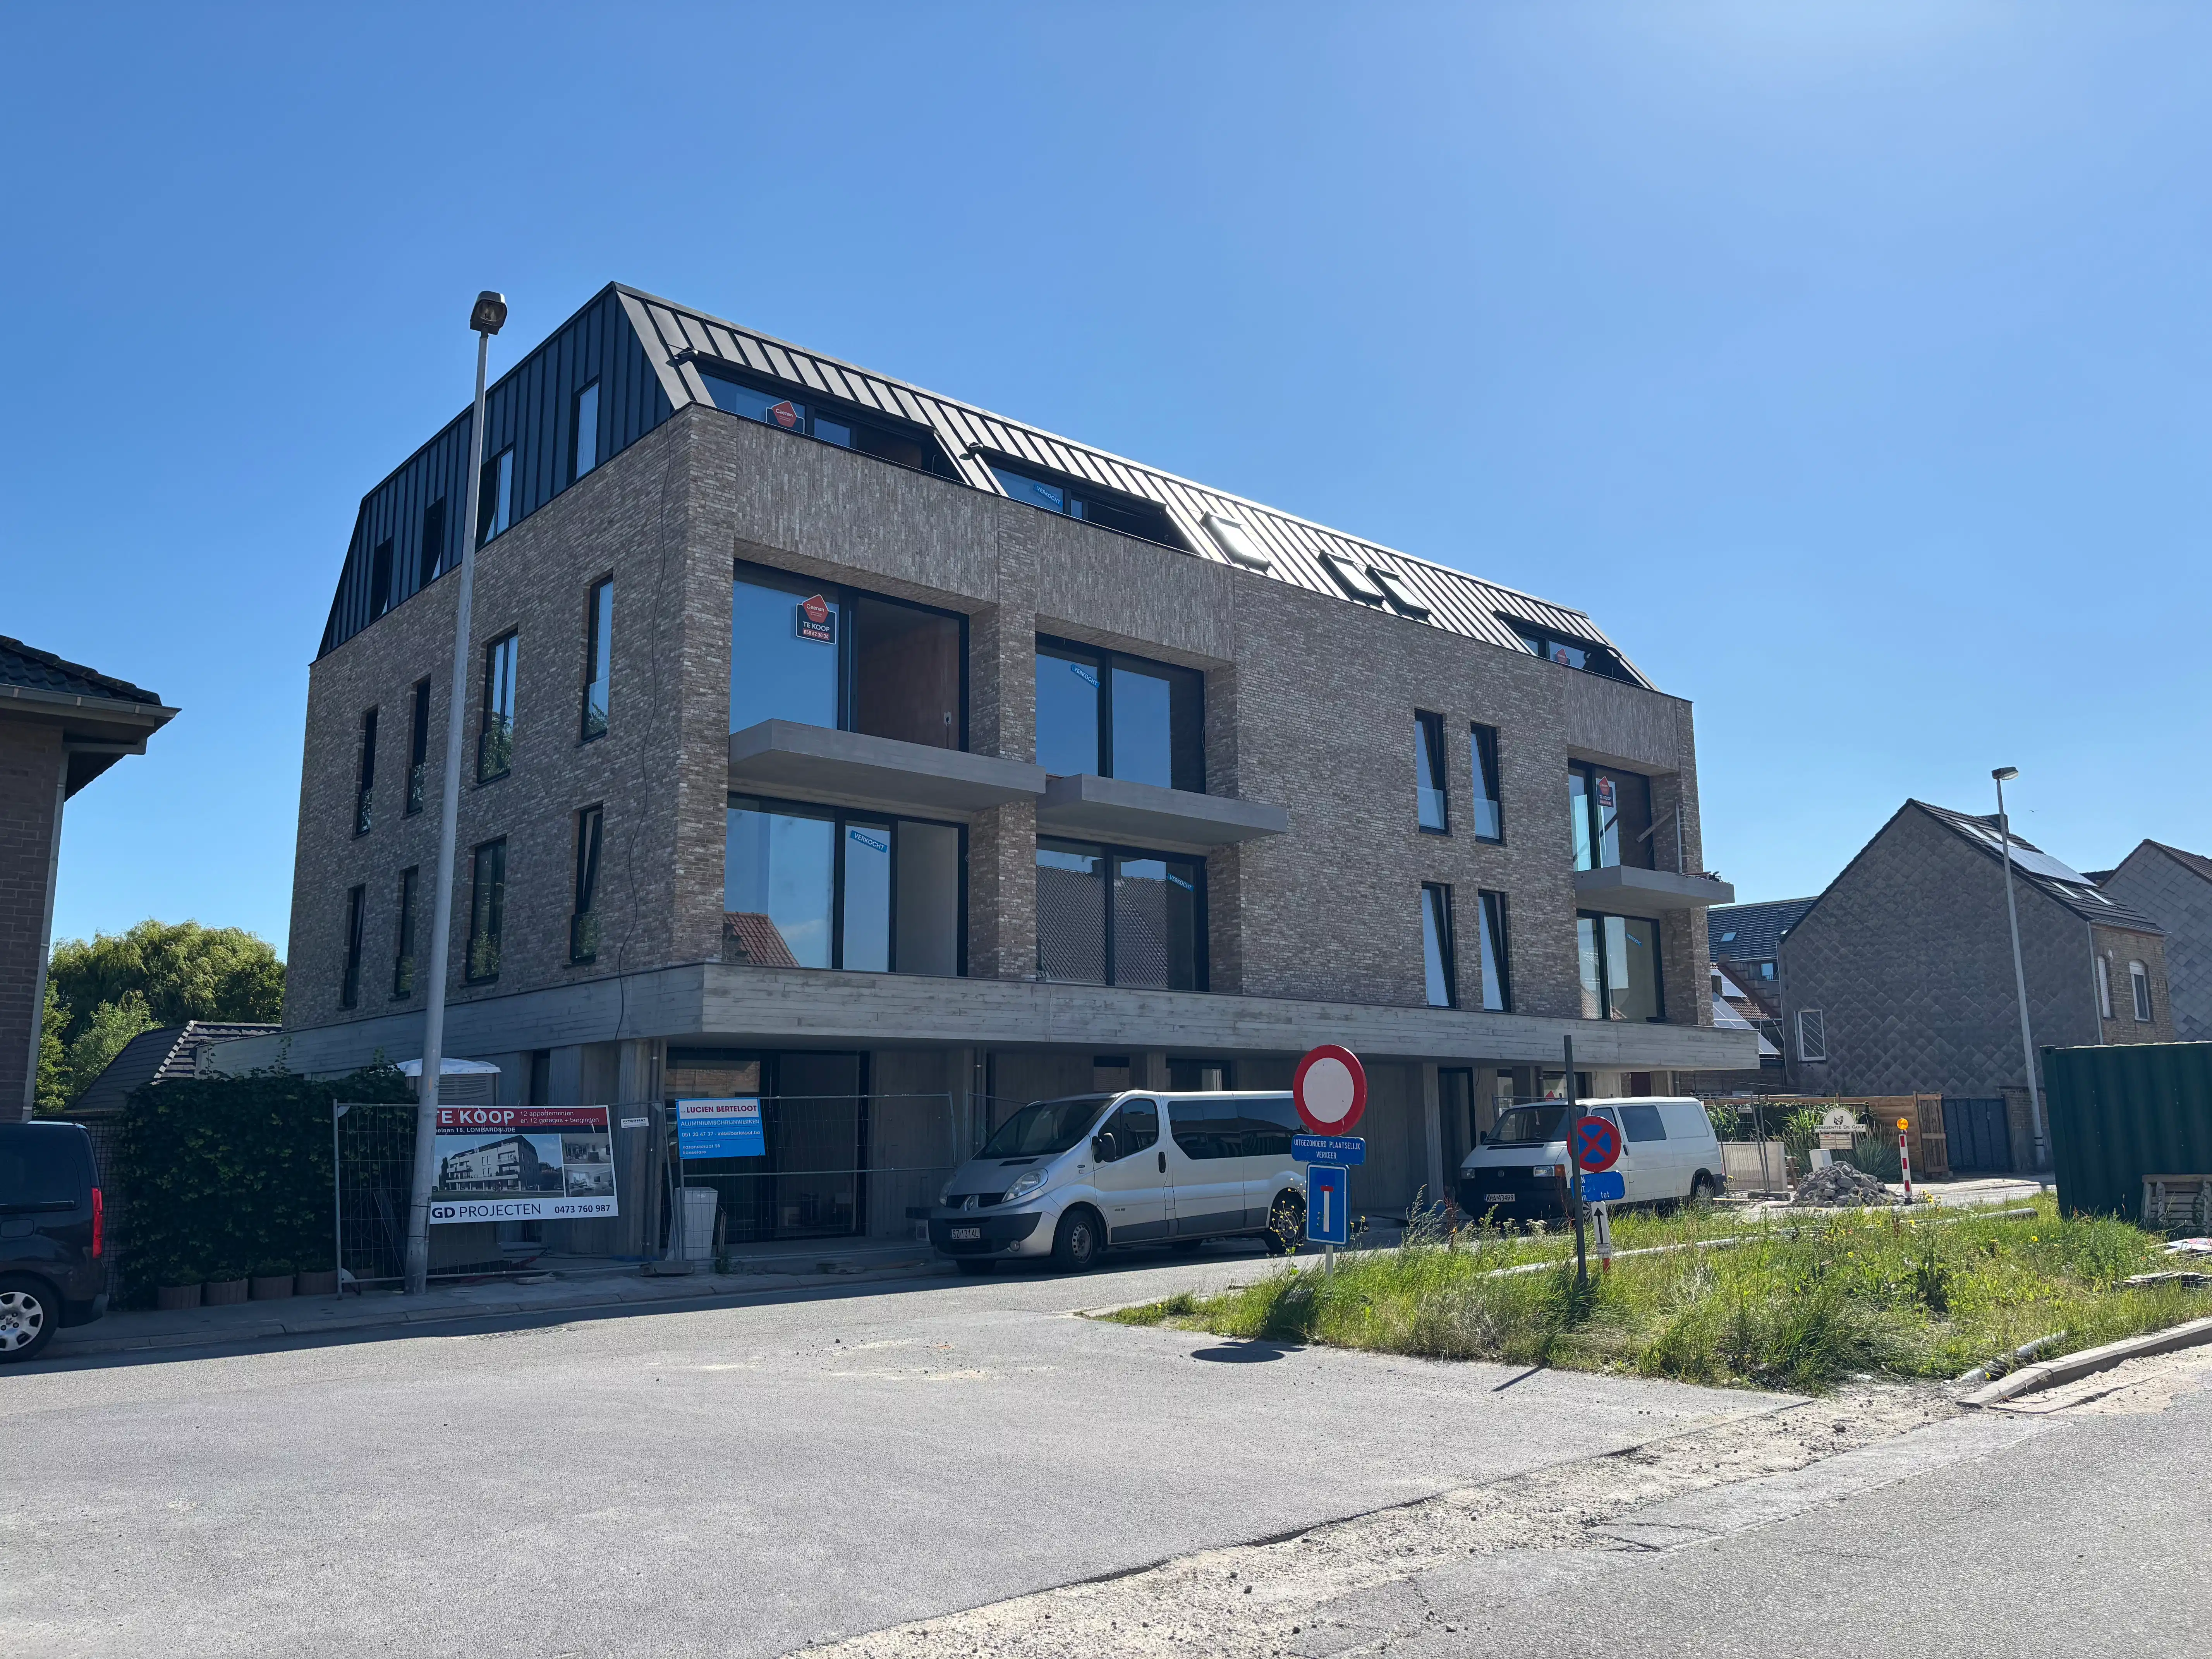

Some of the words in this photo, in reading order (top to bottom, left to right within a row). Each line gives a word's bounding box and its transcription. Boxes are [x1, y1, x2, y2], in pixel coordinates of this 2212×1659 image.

[1037, 486, 1061, 504] VERKOCHT
[806, 604, 824, 612] Caenen
[812, 623, 830, 632] KOOP
[1074, 666, 1098, 685] VERKOCHT
[854, 832, 885, 850] VERKOCHT
[1170, 874, 1192, 890] VERKOCHT
[460, 1110, 515, 1124] KOOP
[1294, 1139, 1327, 1148] UITGEZONDERD
[1329, 1141, 1360, 1150] PLAATSELIJK
[1316, 1151, 1337, 1159] VERKEER
[432, 1207, 455, 1219] GD
[459, 1203, 541, 1218] PROJECTEN
[555, 1206, 575, 1214] 0473
[577, 1205, 593, 1213] 760
